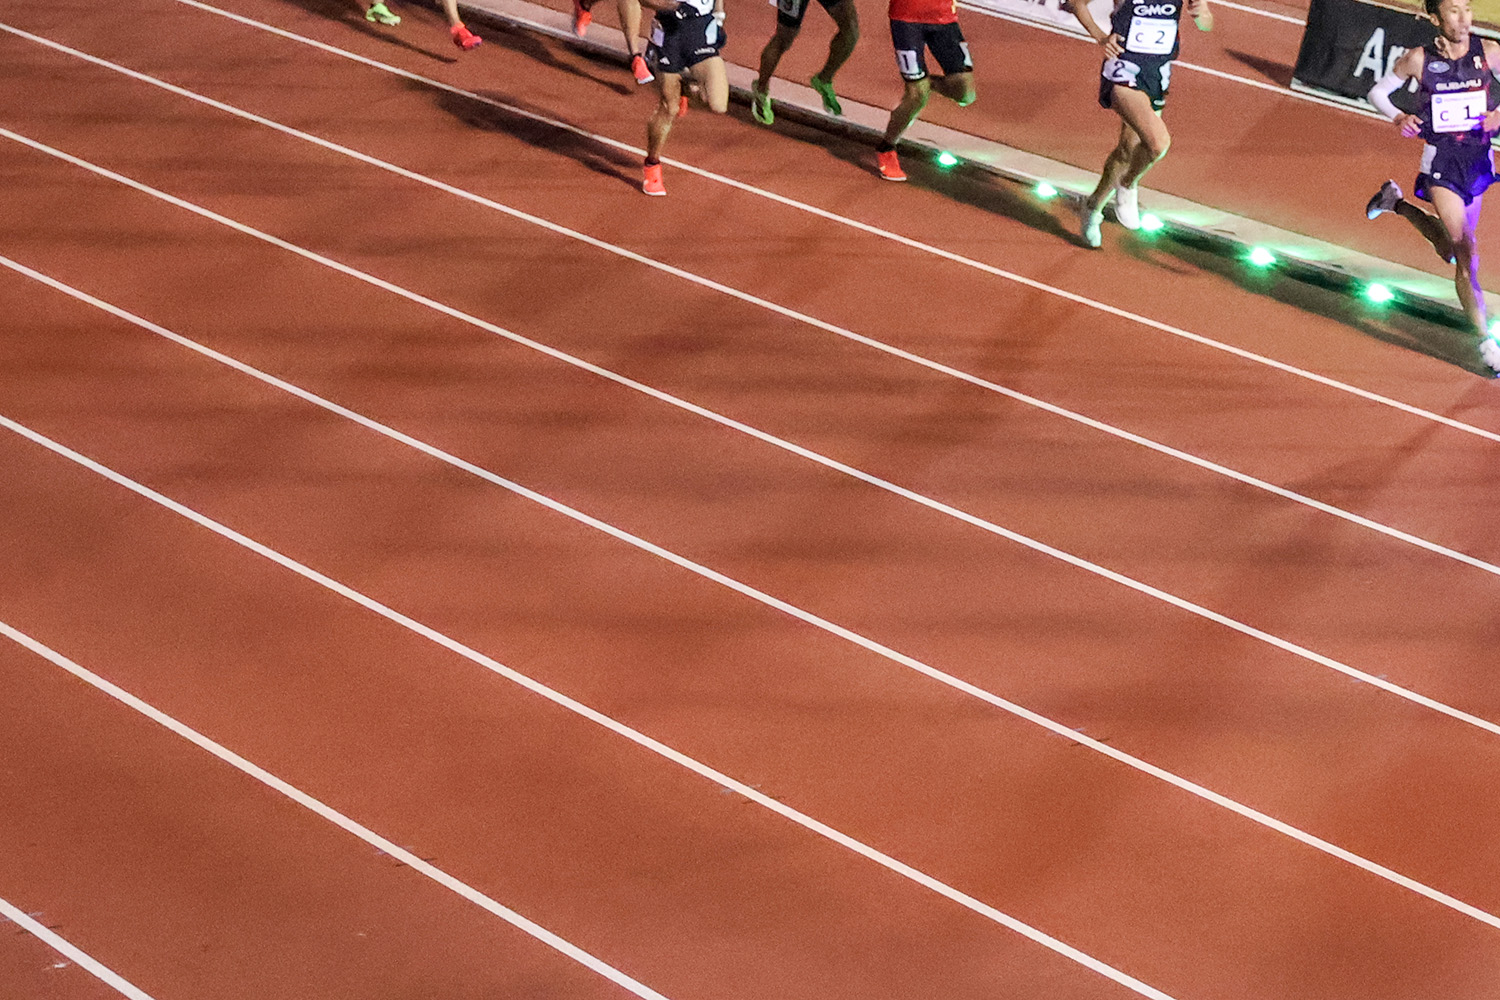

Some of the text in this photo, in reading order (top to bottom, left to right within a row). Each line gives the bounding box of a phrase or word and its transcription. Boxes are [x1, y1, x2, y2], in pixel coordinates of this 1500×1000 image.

[1133, 3, 1177, 17] GMO
[1154, 30, 1166, 45] 2
[1112, 60, 1125, 78] 2
[1435, 78, 1483, 92] SUBARU
[1440, 105, 1474, 122] C 1
